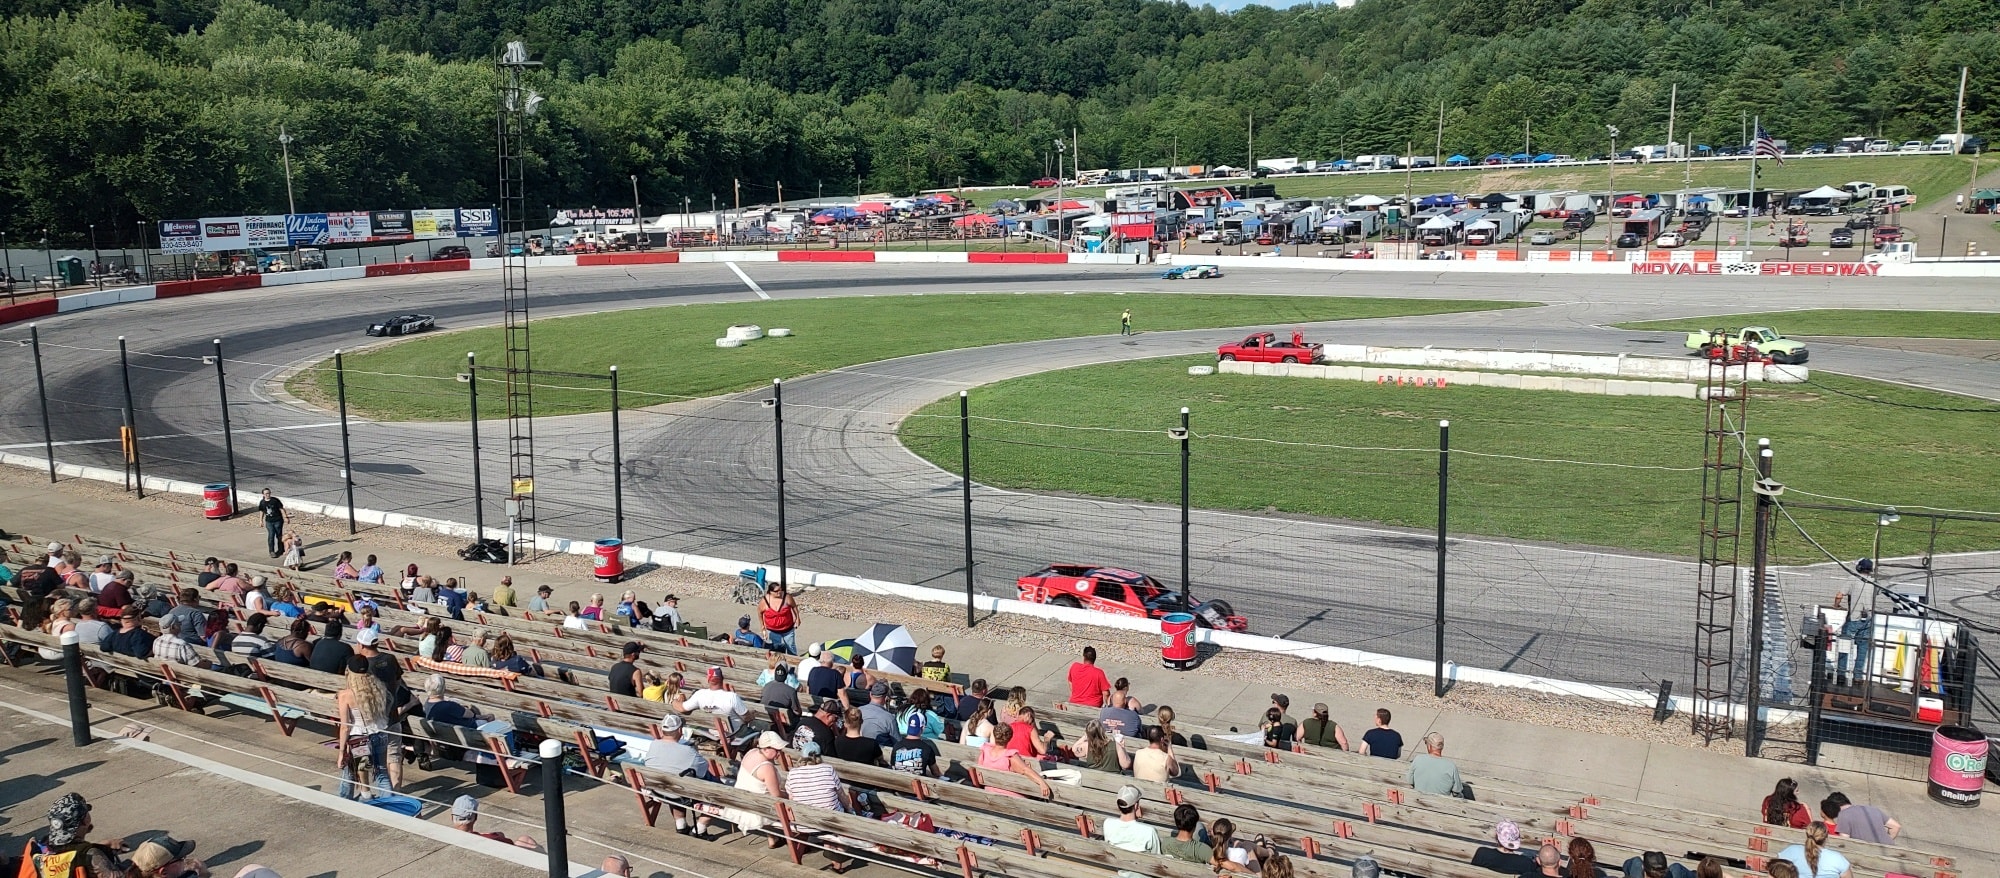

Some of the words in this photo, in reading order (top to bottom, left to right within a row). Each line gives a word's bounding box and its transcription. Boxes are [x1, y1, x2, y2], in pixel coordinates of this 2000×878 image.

[461, 210, 491, 222] SSB
[246, 221, 285, 229] PERFORMANCE
[1632, 262, 1722, 275] MIDVALE
[1760, 263, 1883, 276] SPEEDWAY
